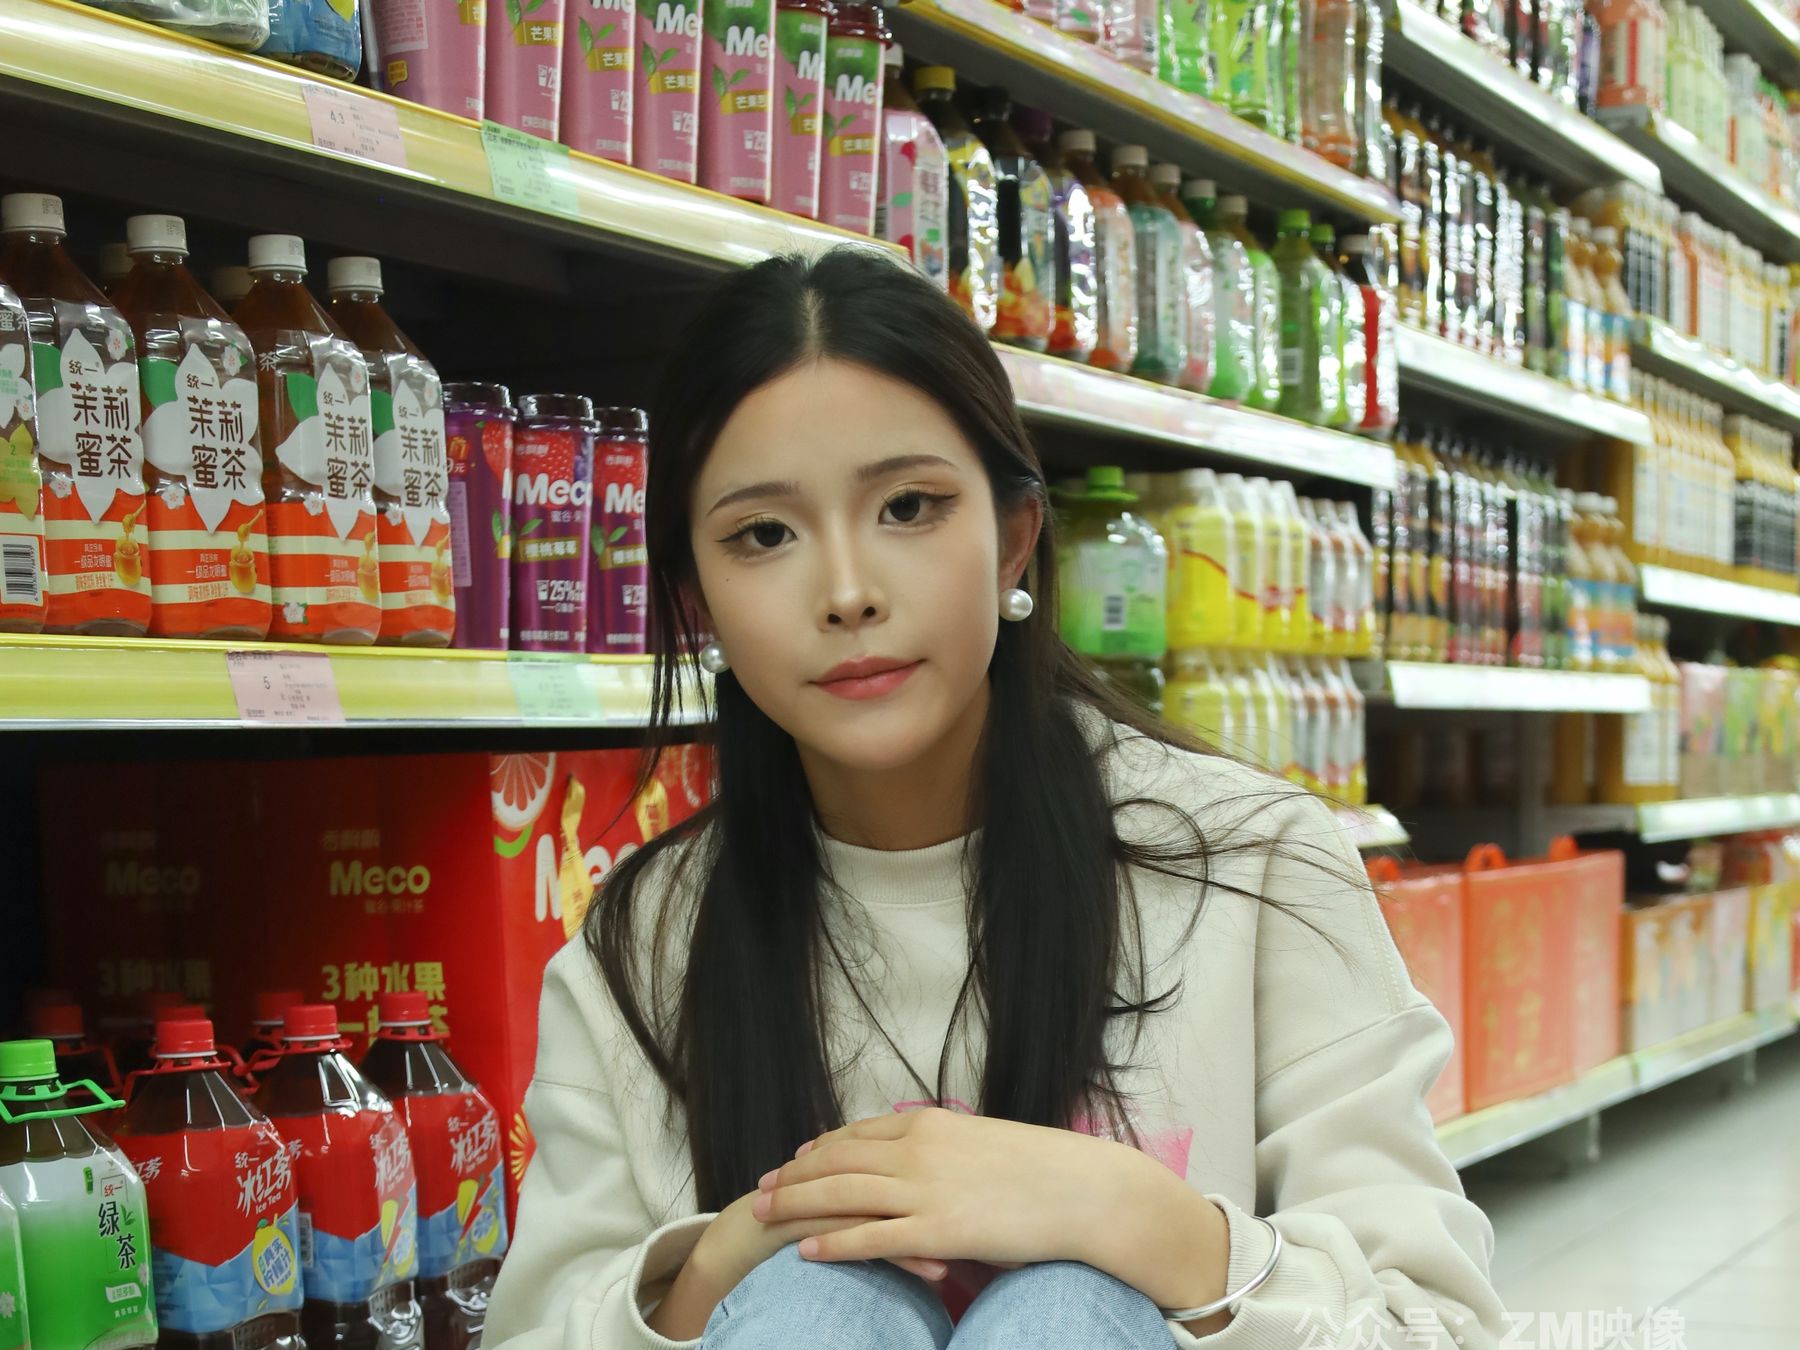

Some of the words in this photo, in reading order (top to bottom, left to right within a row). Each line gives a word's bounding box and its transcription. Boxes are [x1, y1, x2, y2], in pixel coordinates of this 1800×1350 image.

[69, 360, 98, 375] 统一
[186, 374, 214, 389] 统一
[70, 382, 130, 430] 茉莉
[187, 396, 244, 444] 茉莉
[323, 390, 345, 407] 统一
[75, 431, 132, 479] 蜜茶
[324, 411, 369, 458] 茉莉
[400, 425, 441, 468] 茉莉
[192, 444, 248, 491] 蜜茶
[327, 458, 371, 501] 蜜茶
[403, 468, 442, 509] 蜜茶
[330, 860, 431, 896] Meco
[321, 961, 446, 1001] 3种水果
[236, 1148, 292, 1218] 冰红茶
[99, 1201, 136, 1269] 绿茶
